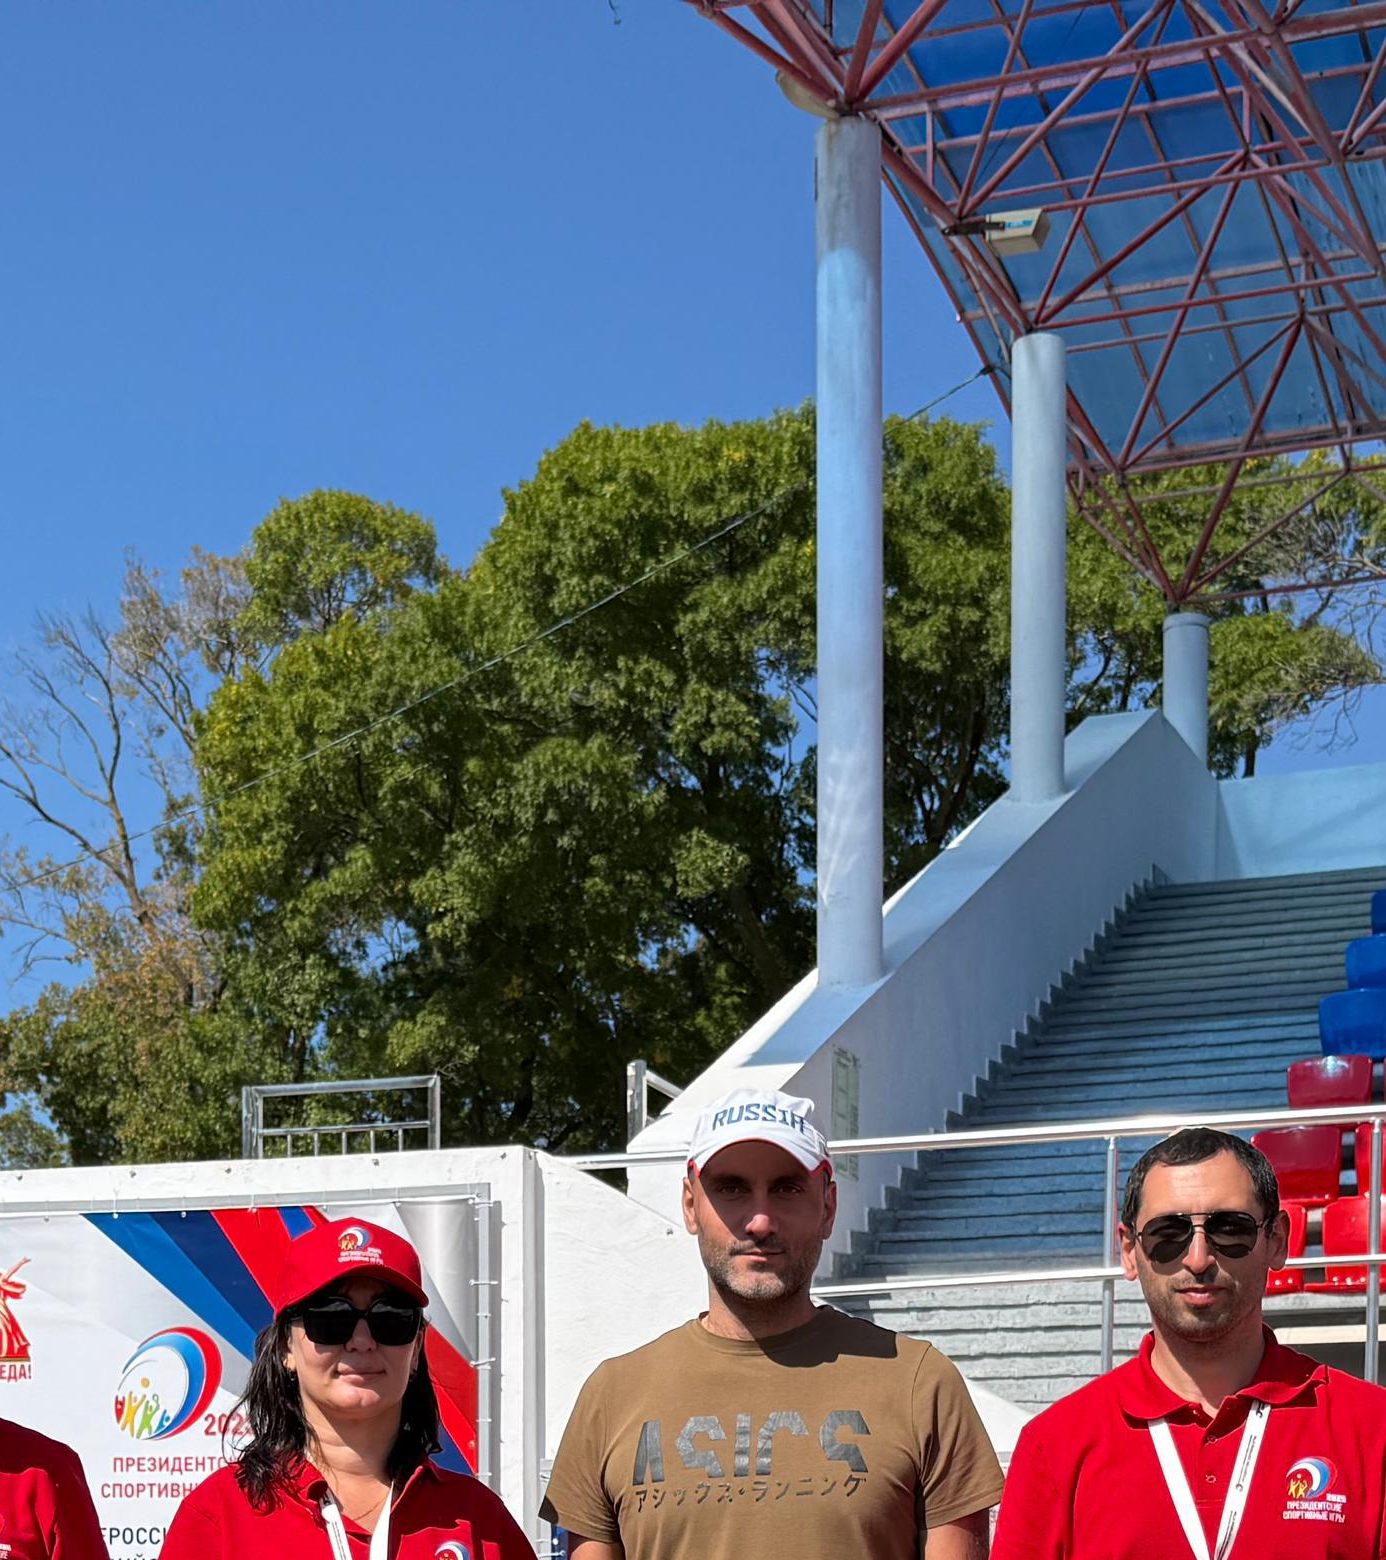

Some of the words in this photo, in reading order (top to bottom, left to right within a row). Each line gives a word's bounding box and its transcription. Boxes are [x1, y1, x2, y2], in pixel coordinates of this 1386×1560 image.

[712, 1103, 804, 1134] RUSSIA
[204, 1413, 254, 1436] 202
[632, 1410, 870, 1486] ASICS
[113, 1456, 235, 1475] ПРЕЗИДЕНТС
[101, 1483, 198, 1498] СПОРТИВН
